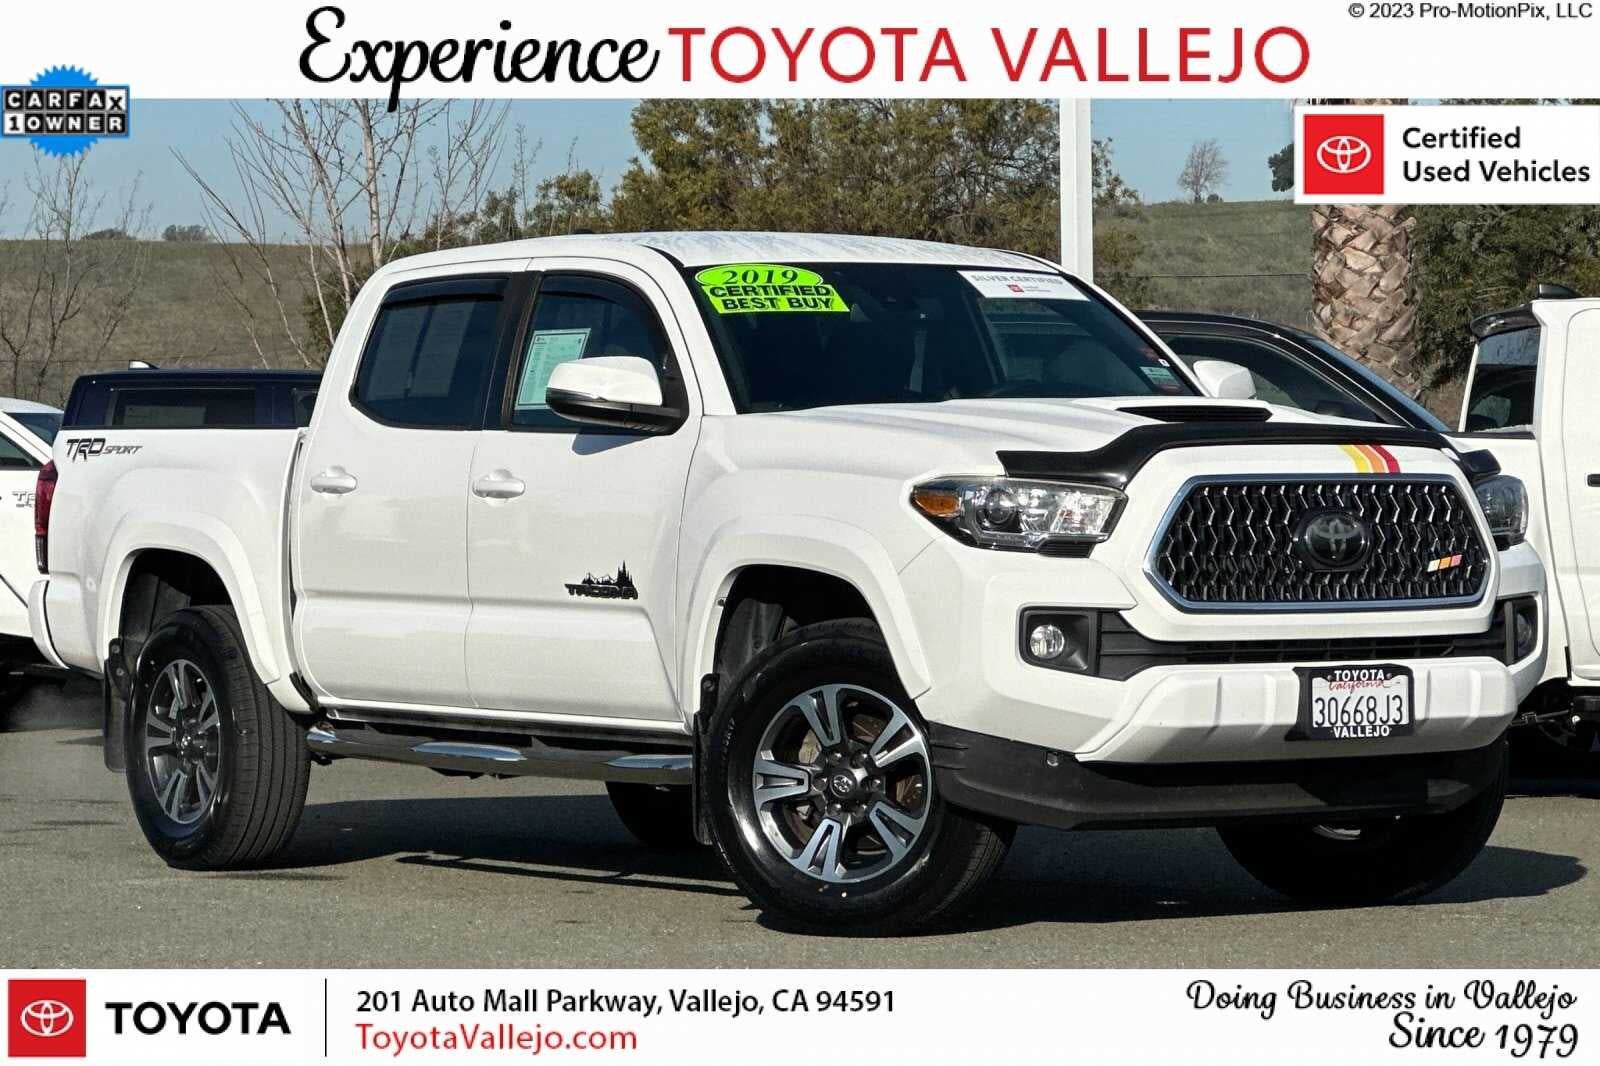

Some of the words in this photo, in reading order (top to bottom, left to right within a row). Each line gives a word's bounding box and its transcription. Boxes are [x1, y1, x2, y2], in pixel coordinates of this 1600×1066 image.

[721, 269, 799, 285] 2019
[709, 285, 832, 298] CERTIFIED
[722, 297, 778, 310] BEST
[788, 297, 832, 309] BUY
[66, 438, 106, 462] TRD
[103, 445, 143, 455] SPORT
[1335, 669, 1385, 681] TOYOTA
[1315, 694, 1403, 726] 30668J3
[1333, 726, 1390, 738] VALLEJO
